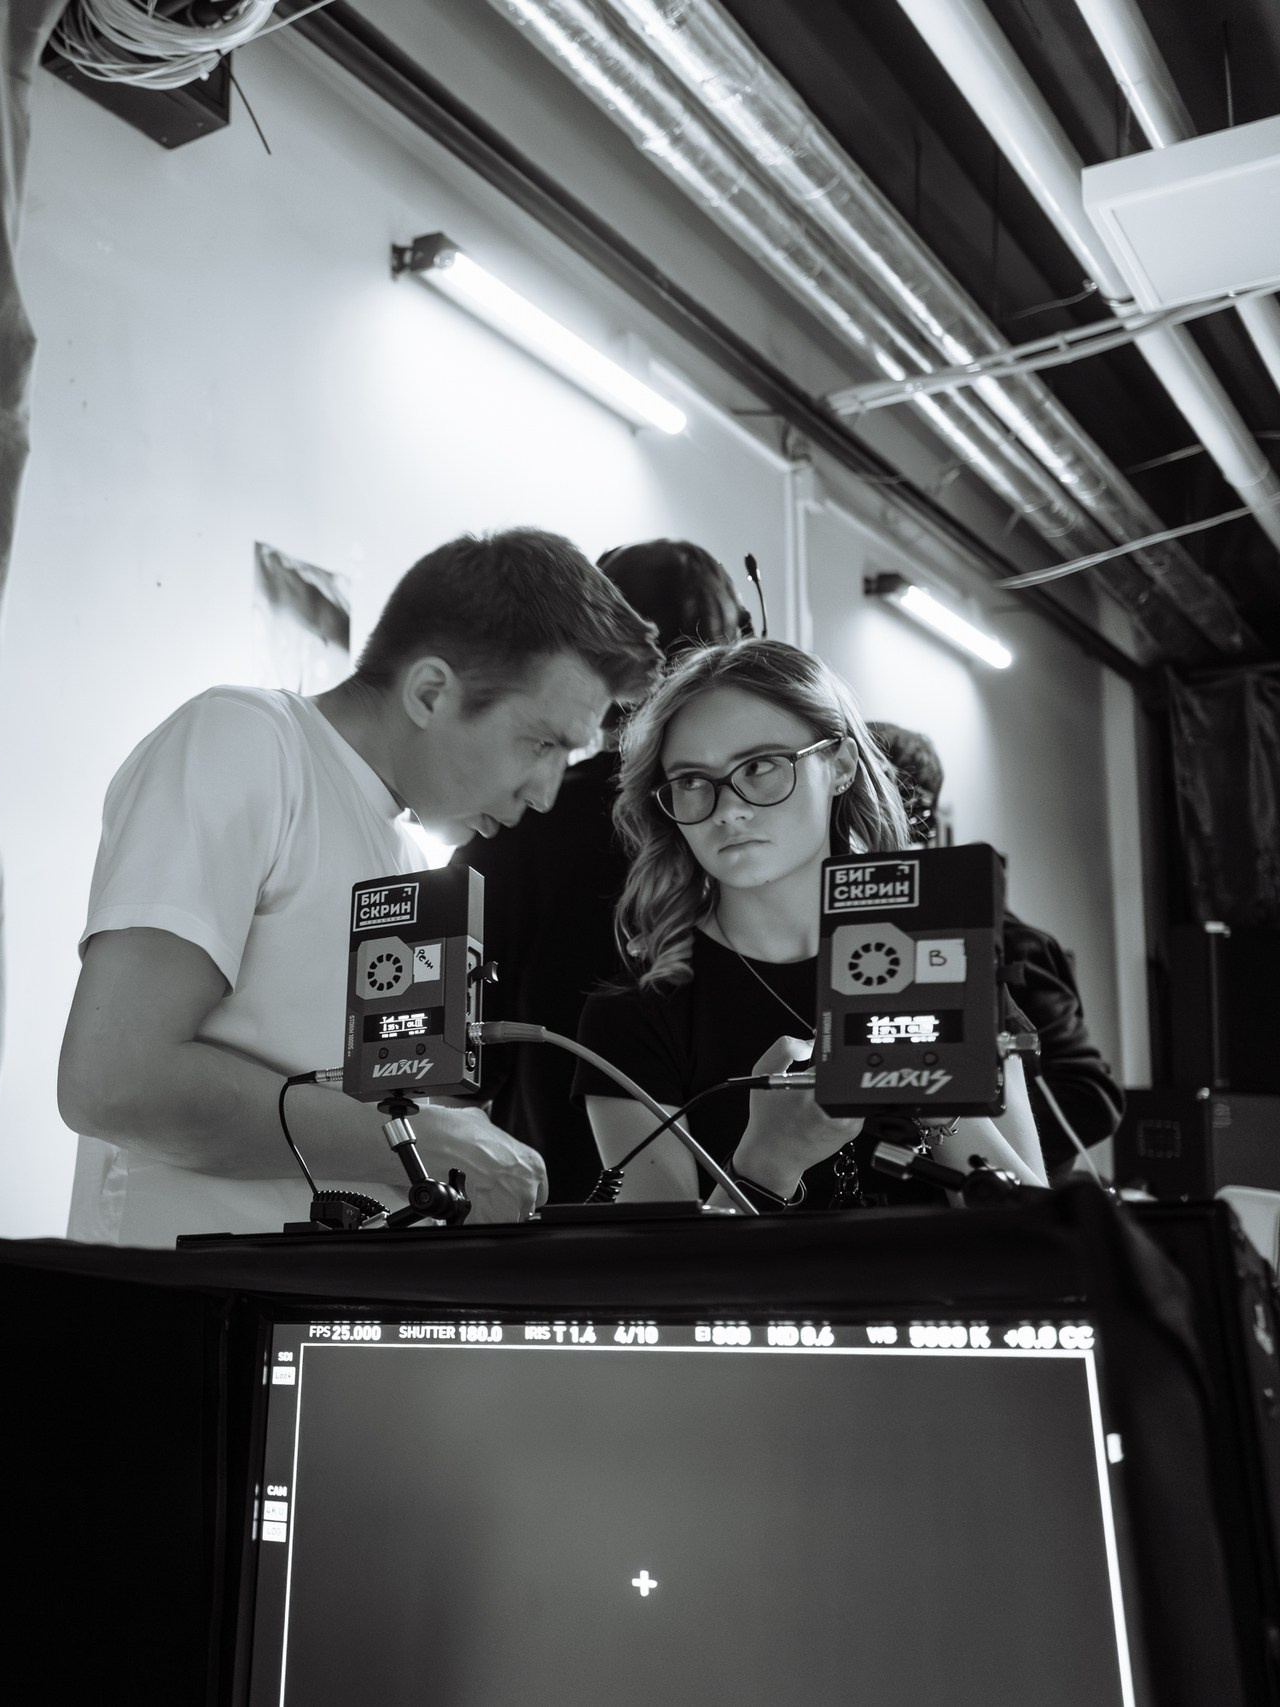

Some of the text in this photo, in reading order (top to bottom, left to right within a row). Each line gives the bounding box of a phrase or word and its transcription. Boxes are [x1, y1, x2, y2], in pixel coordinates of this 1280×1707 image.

[835, 867, 876, 884] БИГ
[361, 890, 389, 906] БИГ
[834, 881, 910, 900] СКРИН
[360, 901, 411, 919] СКРИН
[372, 1058, 434, 1080] VAXIS
[860, 1068, 953, 1095] VAXIS
[309, 1325, 382, 1341] FPS 25.000
[399, 1325, 503, 1343] SHUTTER 180.0
[524, 1325, 552, 1341] IRIS
[553, 1325, 568, 1344] T
[568, 1325, 598, 1344] 1.4
[266, 1485, 288, 1497] CAM
